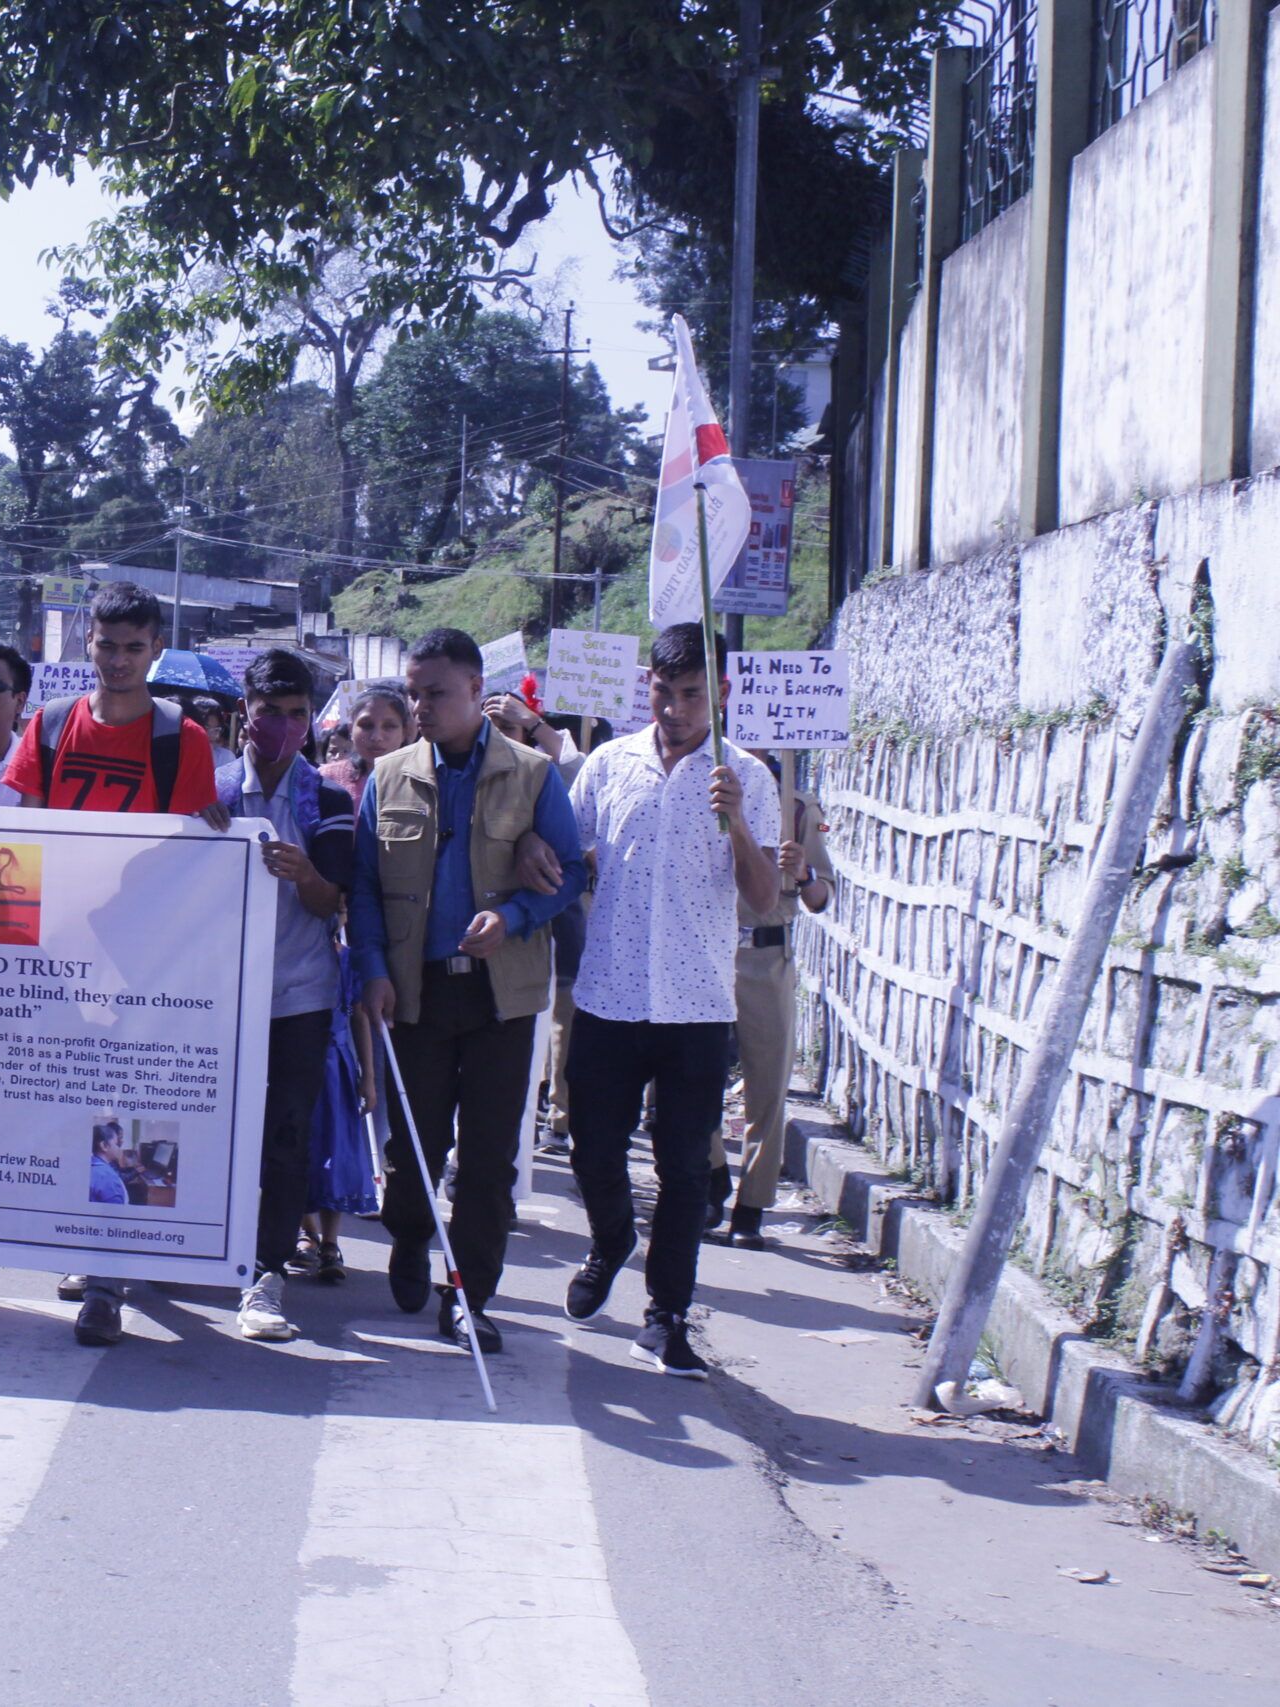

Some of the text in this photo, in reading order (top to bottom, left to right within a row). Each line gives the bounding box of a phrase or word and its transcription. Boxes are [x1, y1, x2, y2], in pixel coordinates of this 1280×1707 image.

[738, 656, 832, 675] WE NEED TO
[741, 678, 778, 695] HELP
[738, 702, 816, 719] ER WITH
[61, 769, 142, 812] 77
[16, 958, 92, 979] TRUST
[20, 984, 69, 1003] blind,
[74, 988, 111, 1006] they
[116, 994, 146, 1006] can
[152, 994, 214, 1010] choose
[13, 1032, 22, 1042] is
[27, 1036, 34, 1044] a
[38, 1035, 96, 1048] non-profit
[100, 1038, 178, 1054] Organization,
[182, 1043, 190, 1054] it
[195, 1046, 218, 1056] was
[8, 1046, 34, 1057] 2018
[39, 1050, 52, 1058] as
[66, 1050, 100, 1062] Public
[104, 1054, 134, 1065] Trust
[138, 1056, 172, 1068] under
[176, 1058, 194, 1068] the
[198, 1059, 218, 1070] Act
[30, 1062, 41, 1072] of
[46, 1064, 67, 1074] this
[74, 1066, 100, 1077] trust
[105, 1070, 128, 1080] was
[135, 1070, 162, 1082] Shri.
[168, 1072, 217, 1084] Jitendra
[10, 1075, 60, 1089] Director)
[66, 1080, 86, 1090] and
[92, 1082, 116, 1092] Late
[122, 1084, 138, 1094] Dr.
[144, 1086, 200, 1098] Theodore
[206, 1088, 217, 1098] M
[4, 1089, 30, 1100] trust
[34, 1092, 54, 1102] has
[58, 1094, 82, 1104] also
[86, 1096, 114, 1108] been
[117, 1098, 177, 1112] registered
[181, 1102, 216, 1114] under
[29, 1156, 60, 1169] Road
[18, 1171, 57, 1186] INDIA.
[55, 1224, 184, 1245] website: blindlead.org
